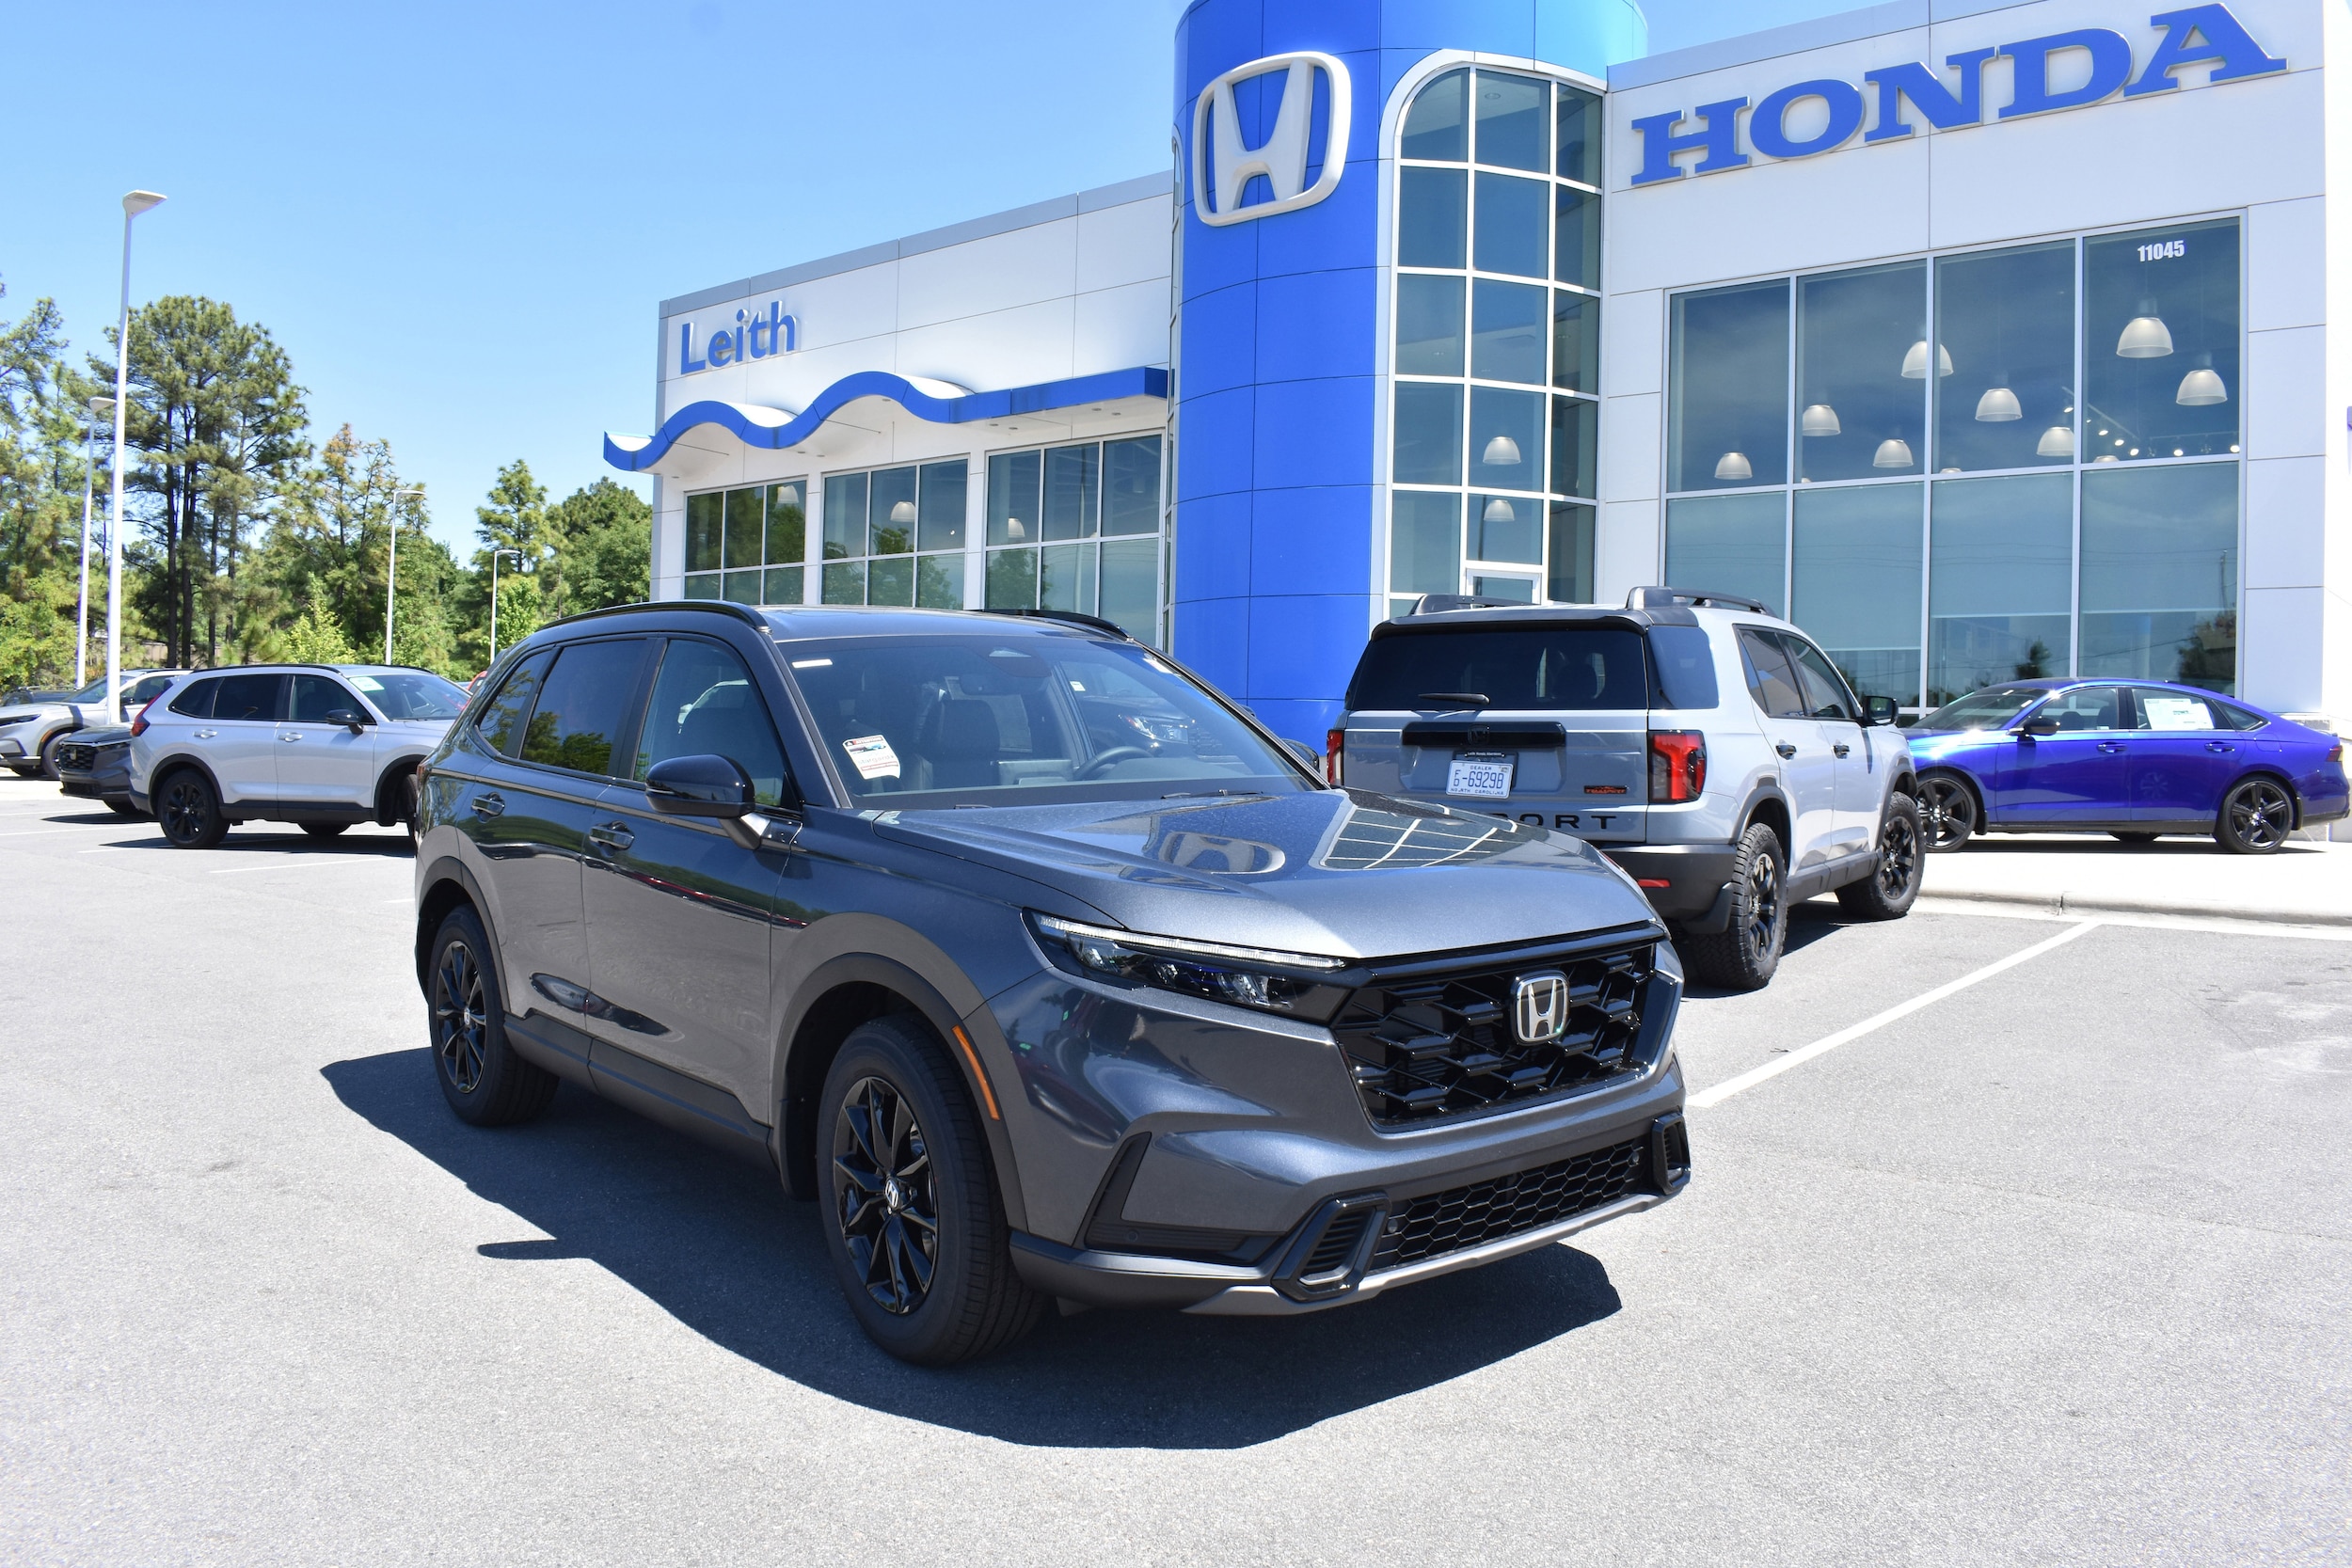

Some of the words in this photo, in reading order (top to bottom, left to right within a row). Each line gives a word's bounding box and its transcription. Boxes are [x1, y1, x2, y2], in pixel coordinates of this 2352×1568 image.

[1630, 2, 2288, 187] HONDA
[2137, 240, 2185, 261] 11045
[680, 300, 796, 375] Leith
